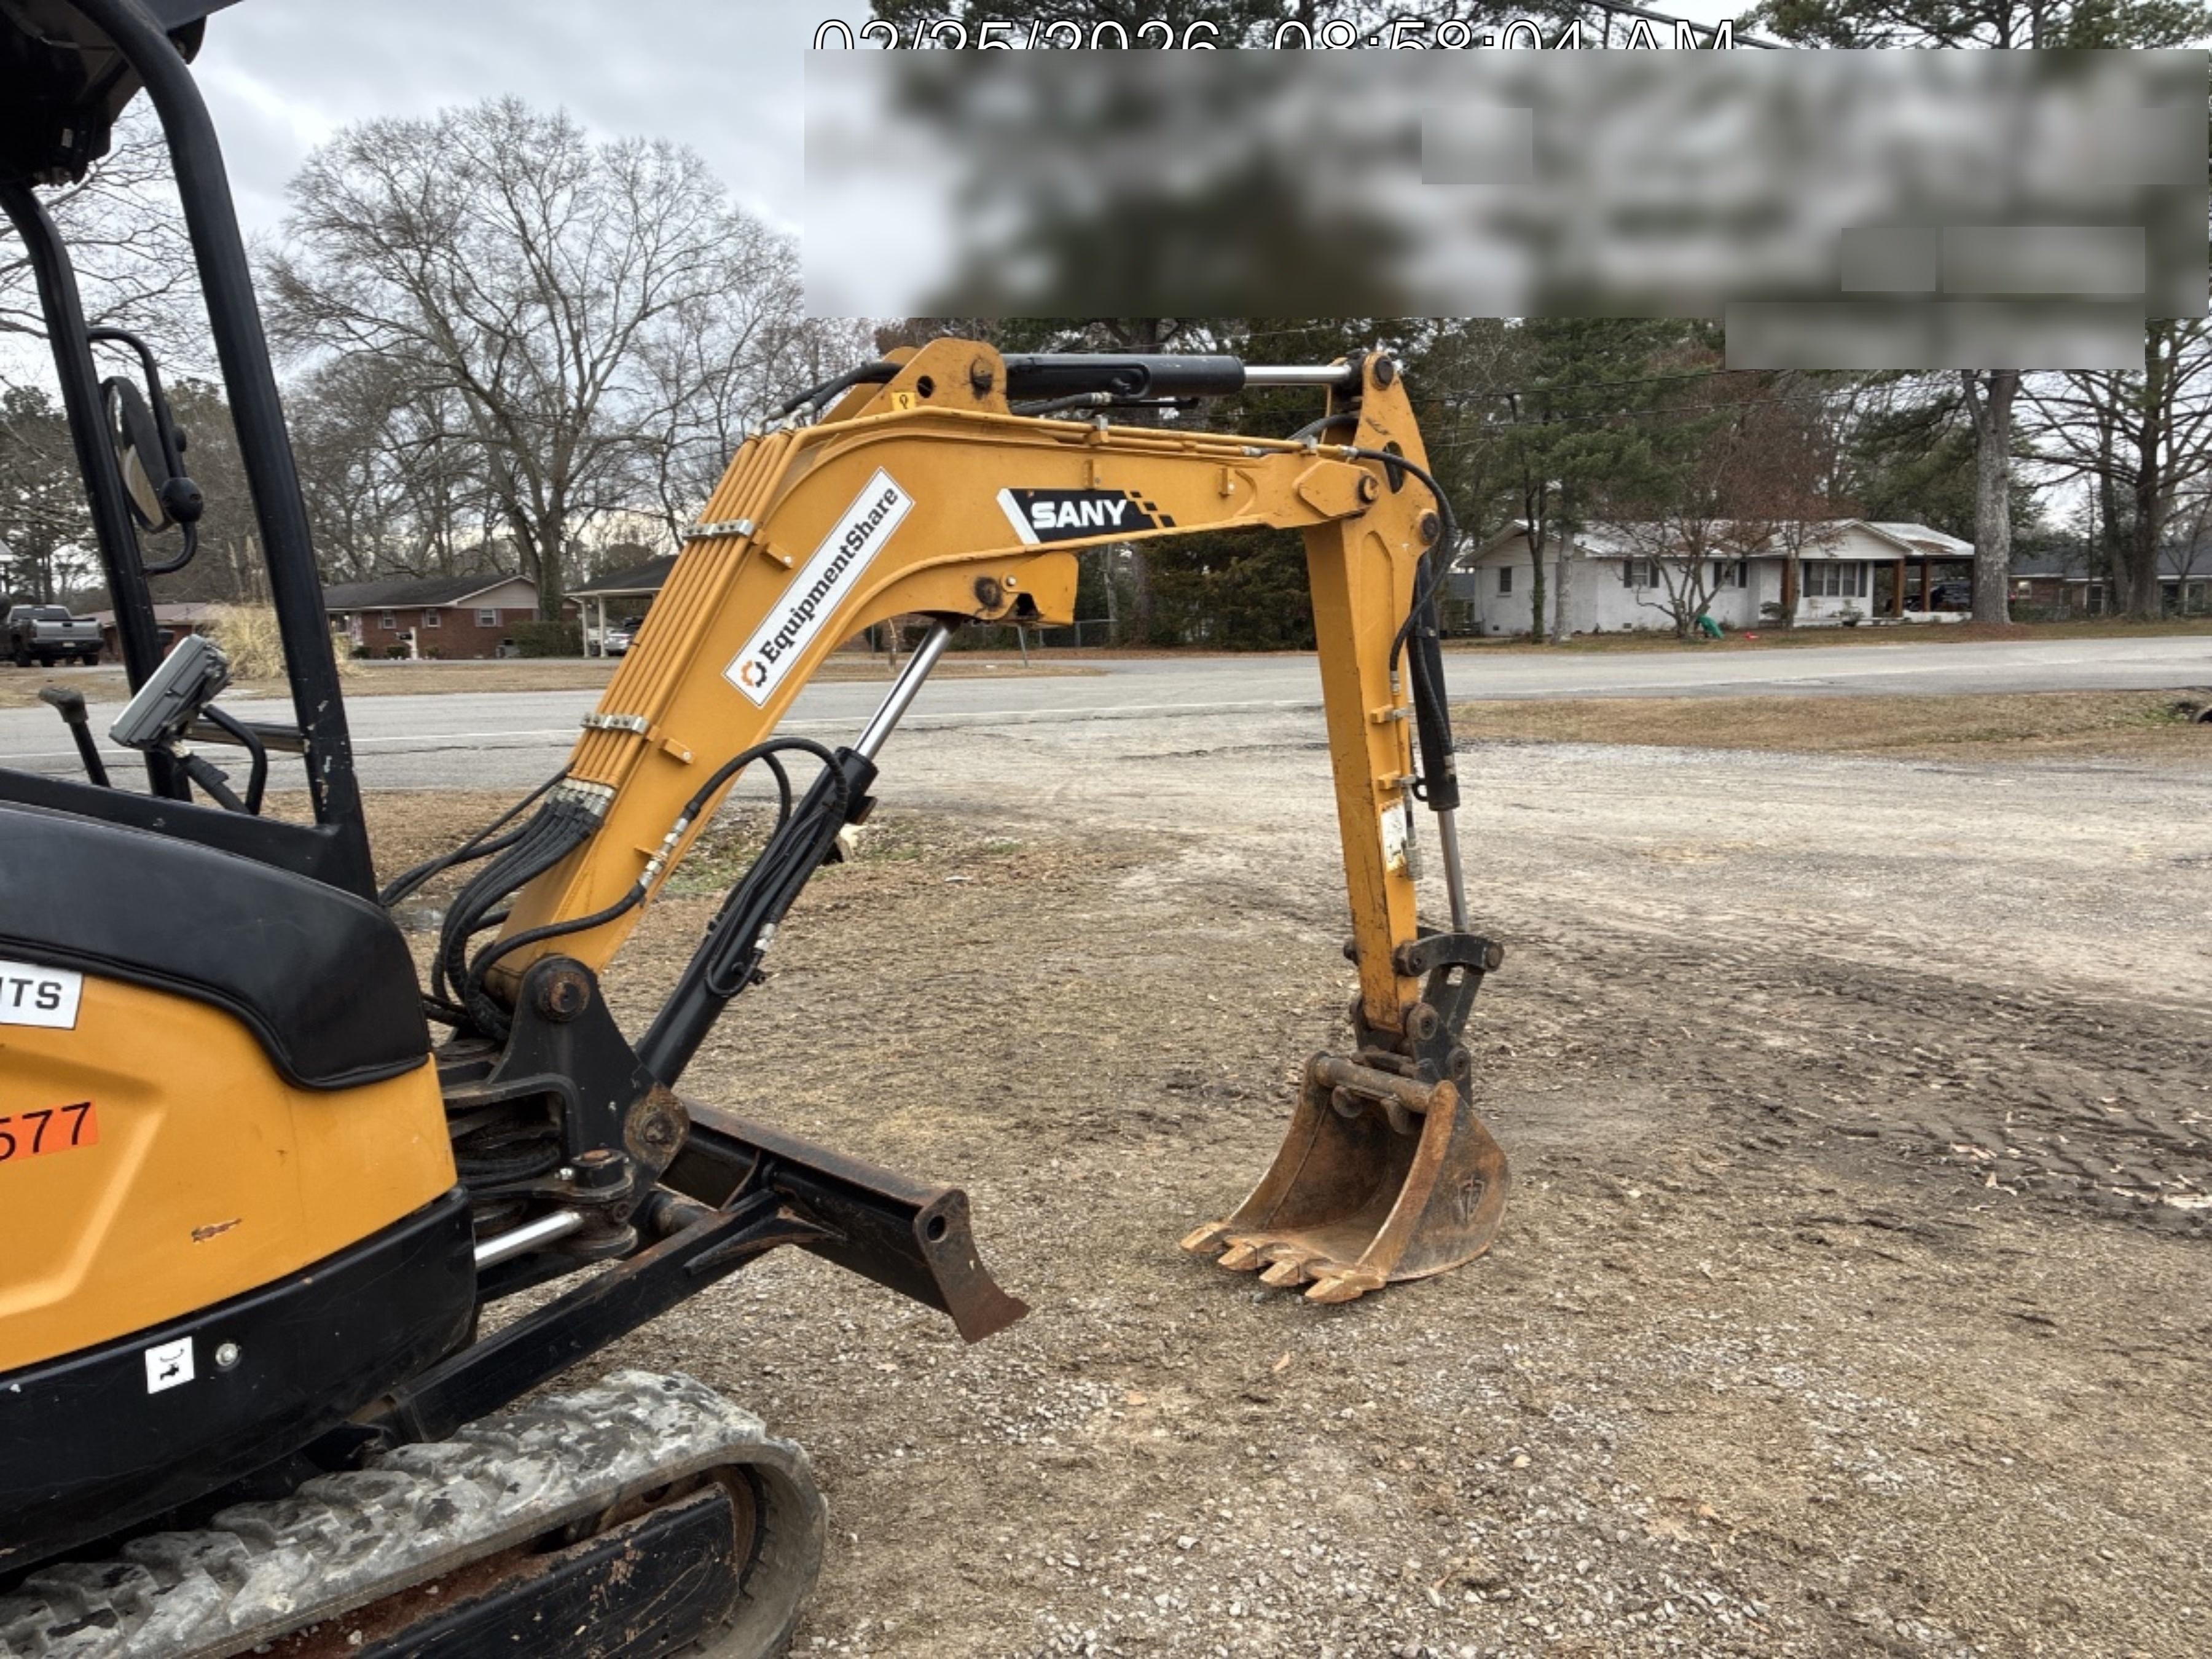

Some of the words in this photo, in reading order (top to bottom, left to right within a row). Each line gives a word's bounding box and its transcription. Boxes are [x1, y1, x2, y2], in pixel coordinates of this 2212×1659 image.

[1030, 499, 1128, 530] SANY
[759, 488, 898, 664] EquipmentShare
[0, 977, 63, 1010] TS
